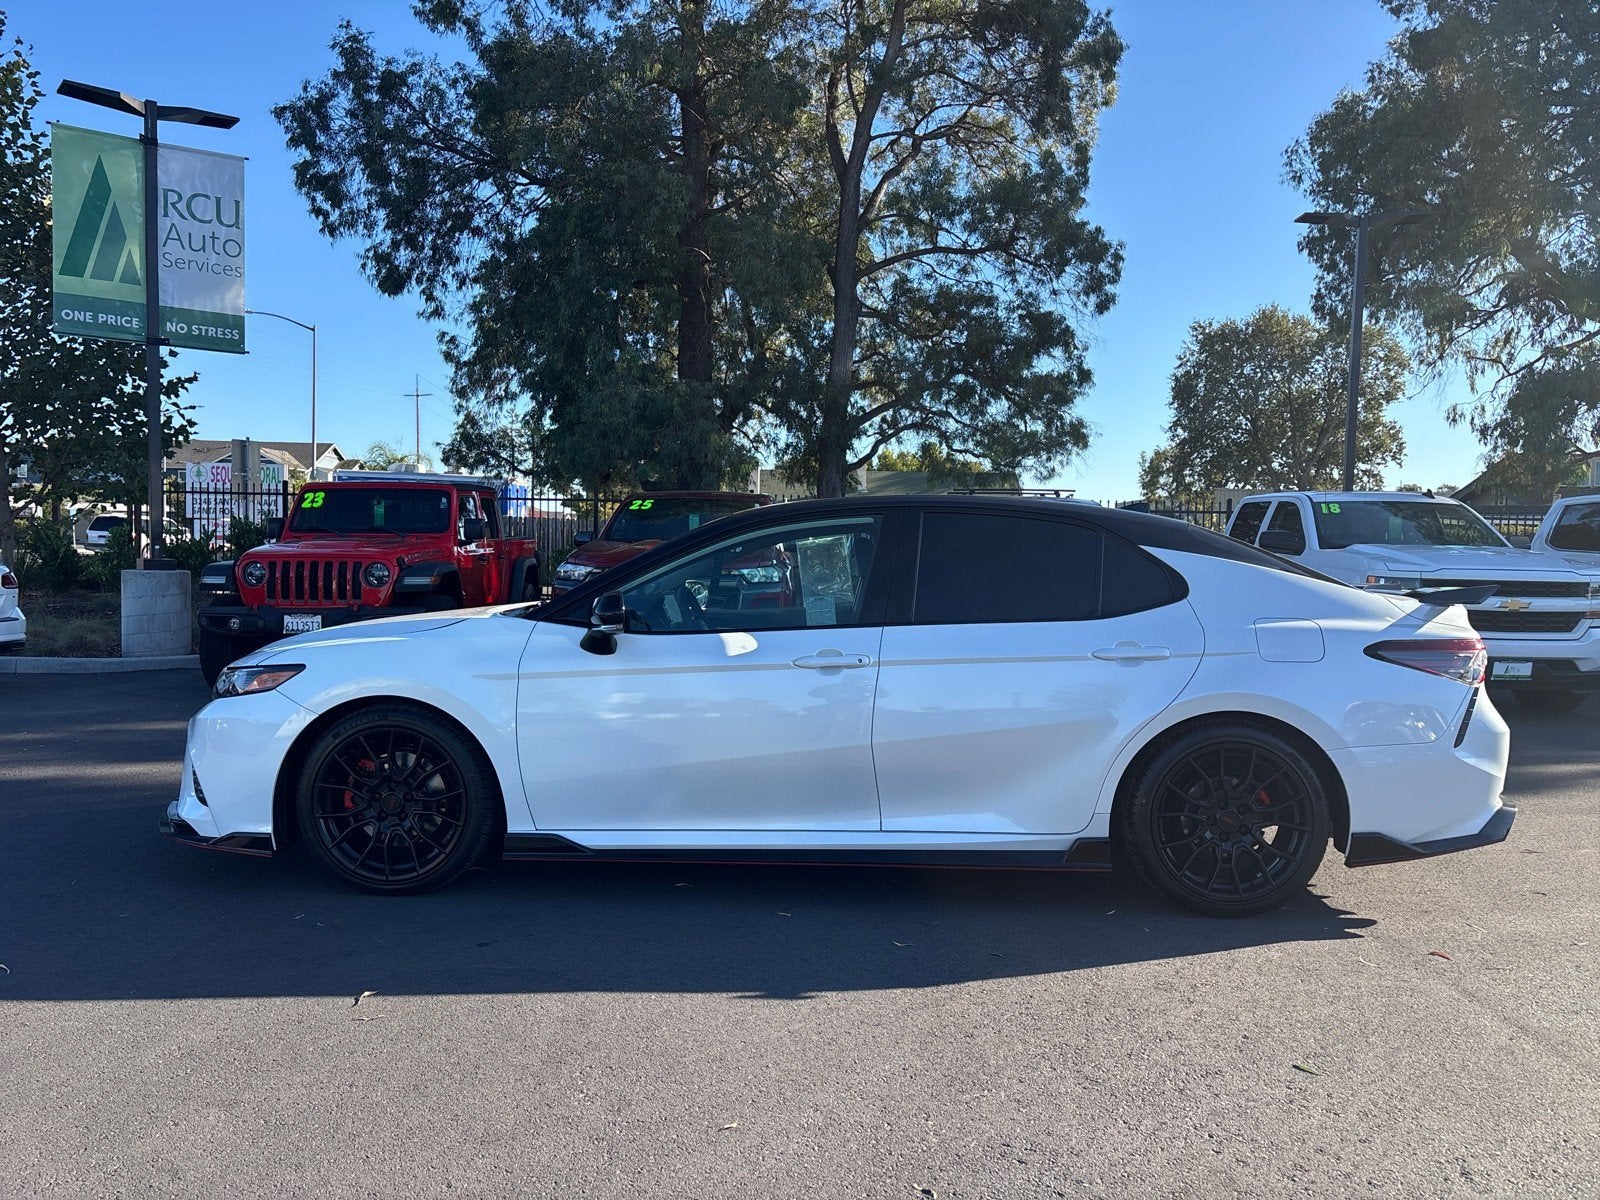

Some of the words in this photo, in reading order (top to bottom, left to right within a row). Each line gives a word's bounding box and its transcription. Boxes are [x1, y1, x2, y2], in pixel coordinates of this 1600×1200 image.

[161, 187, 242, 229] RCU
[162, 222, 242, 258] Auto
[162, 252, 243, 278] Services
[61, 309, 94, 323] ONE
[98, 312, 140, 329] PRICE
[166, 321, 188, 334] NO
[191, 325, 240, 340] STRESS
[301, 491, 325, 508] 23
[629, 499, 654, 510] 25
[1320, 503, 1341, 514] 18
[285, 620, 320, 631] 61135T3
